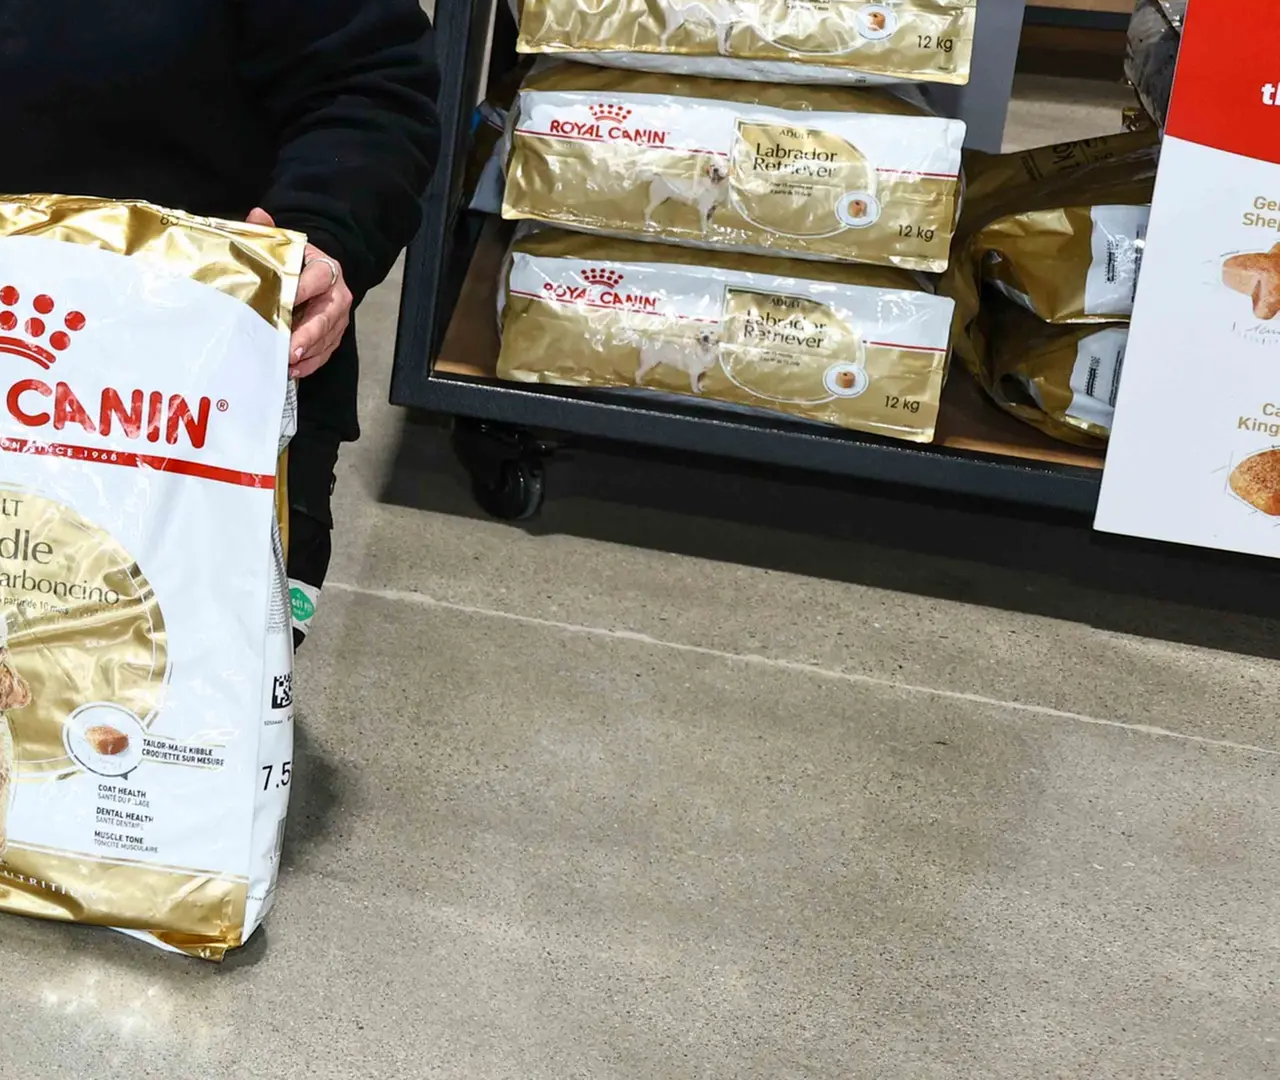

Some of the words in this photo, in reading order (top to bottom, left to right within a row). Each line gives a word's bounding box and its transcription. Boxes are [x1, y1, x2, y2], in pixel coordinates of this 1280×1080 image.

[917, 34, 933, 49] 12
[936, 35, 953, 53] kg
[550, 120, 604, 138] ROYAL
[608, 126, 667, 145] CANIN
[898, 224, 912, 238] 12
[916, 223, 935, 243] kg
[884, 395, 899, 409] 12
[902, 396, 920, 413] kg
[182, 753, 196, 764] SUR
[197, 756, 226, 767] MESURE
[188, 747, 213, 757] KIBBLE
[98, 784, 117, 794] COAT
[118, 788, 147, 799] HEALTH
[127, 798, 151, 809] PLAGE
[96, 806, 124, 820] DENTAL
[125, 812, 154, 824] HEALTH
[94, 830, 124, 843] MUSCLE
[125, 835, 145, 845] TONE
